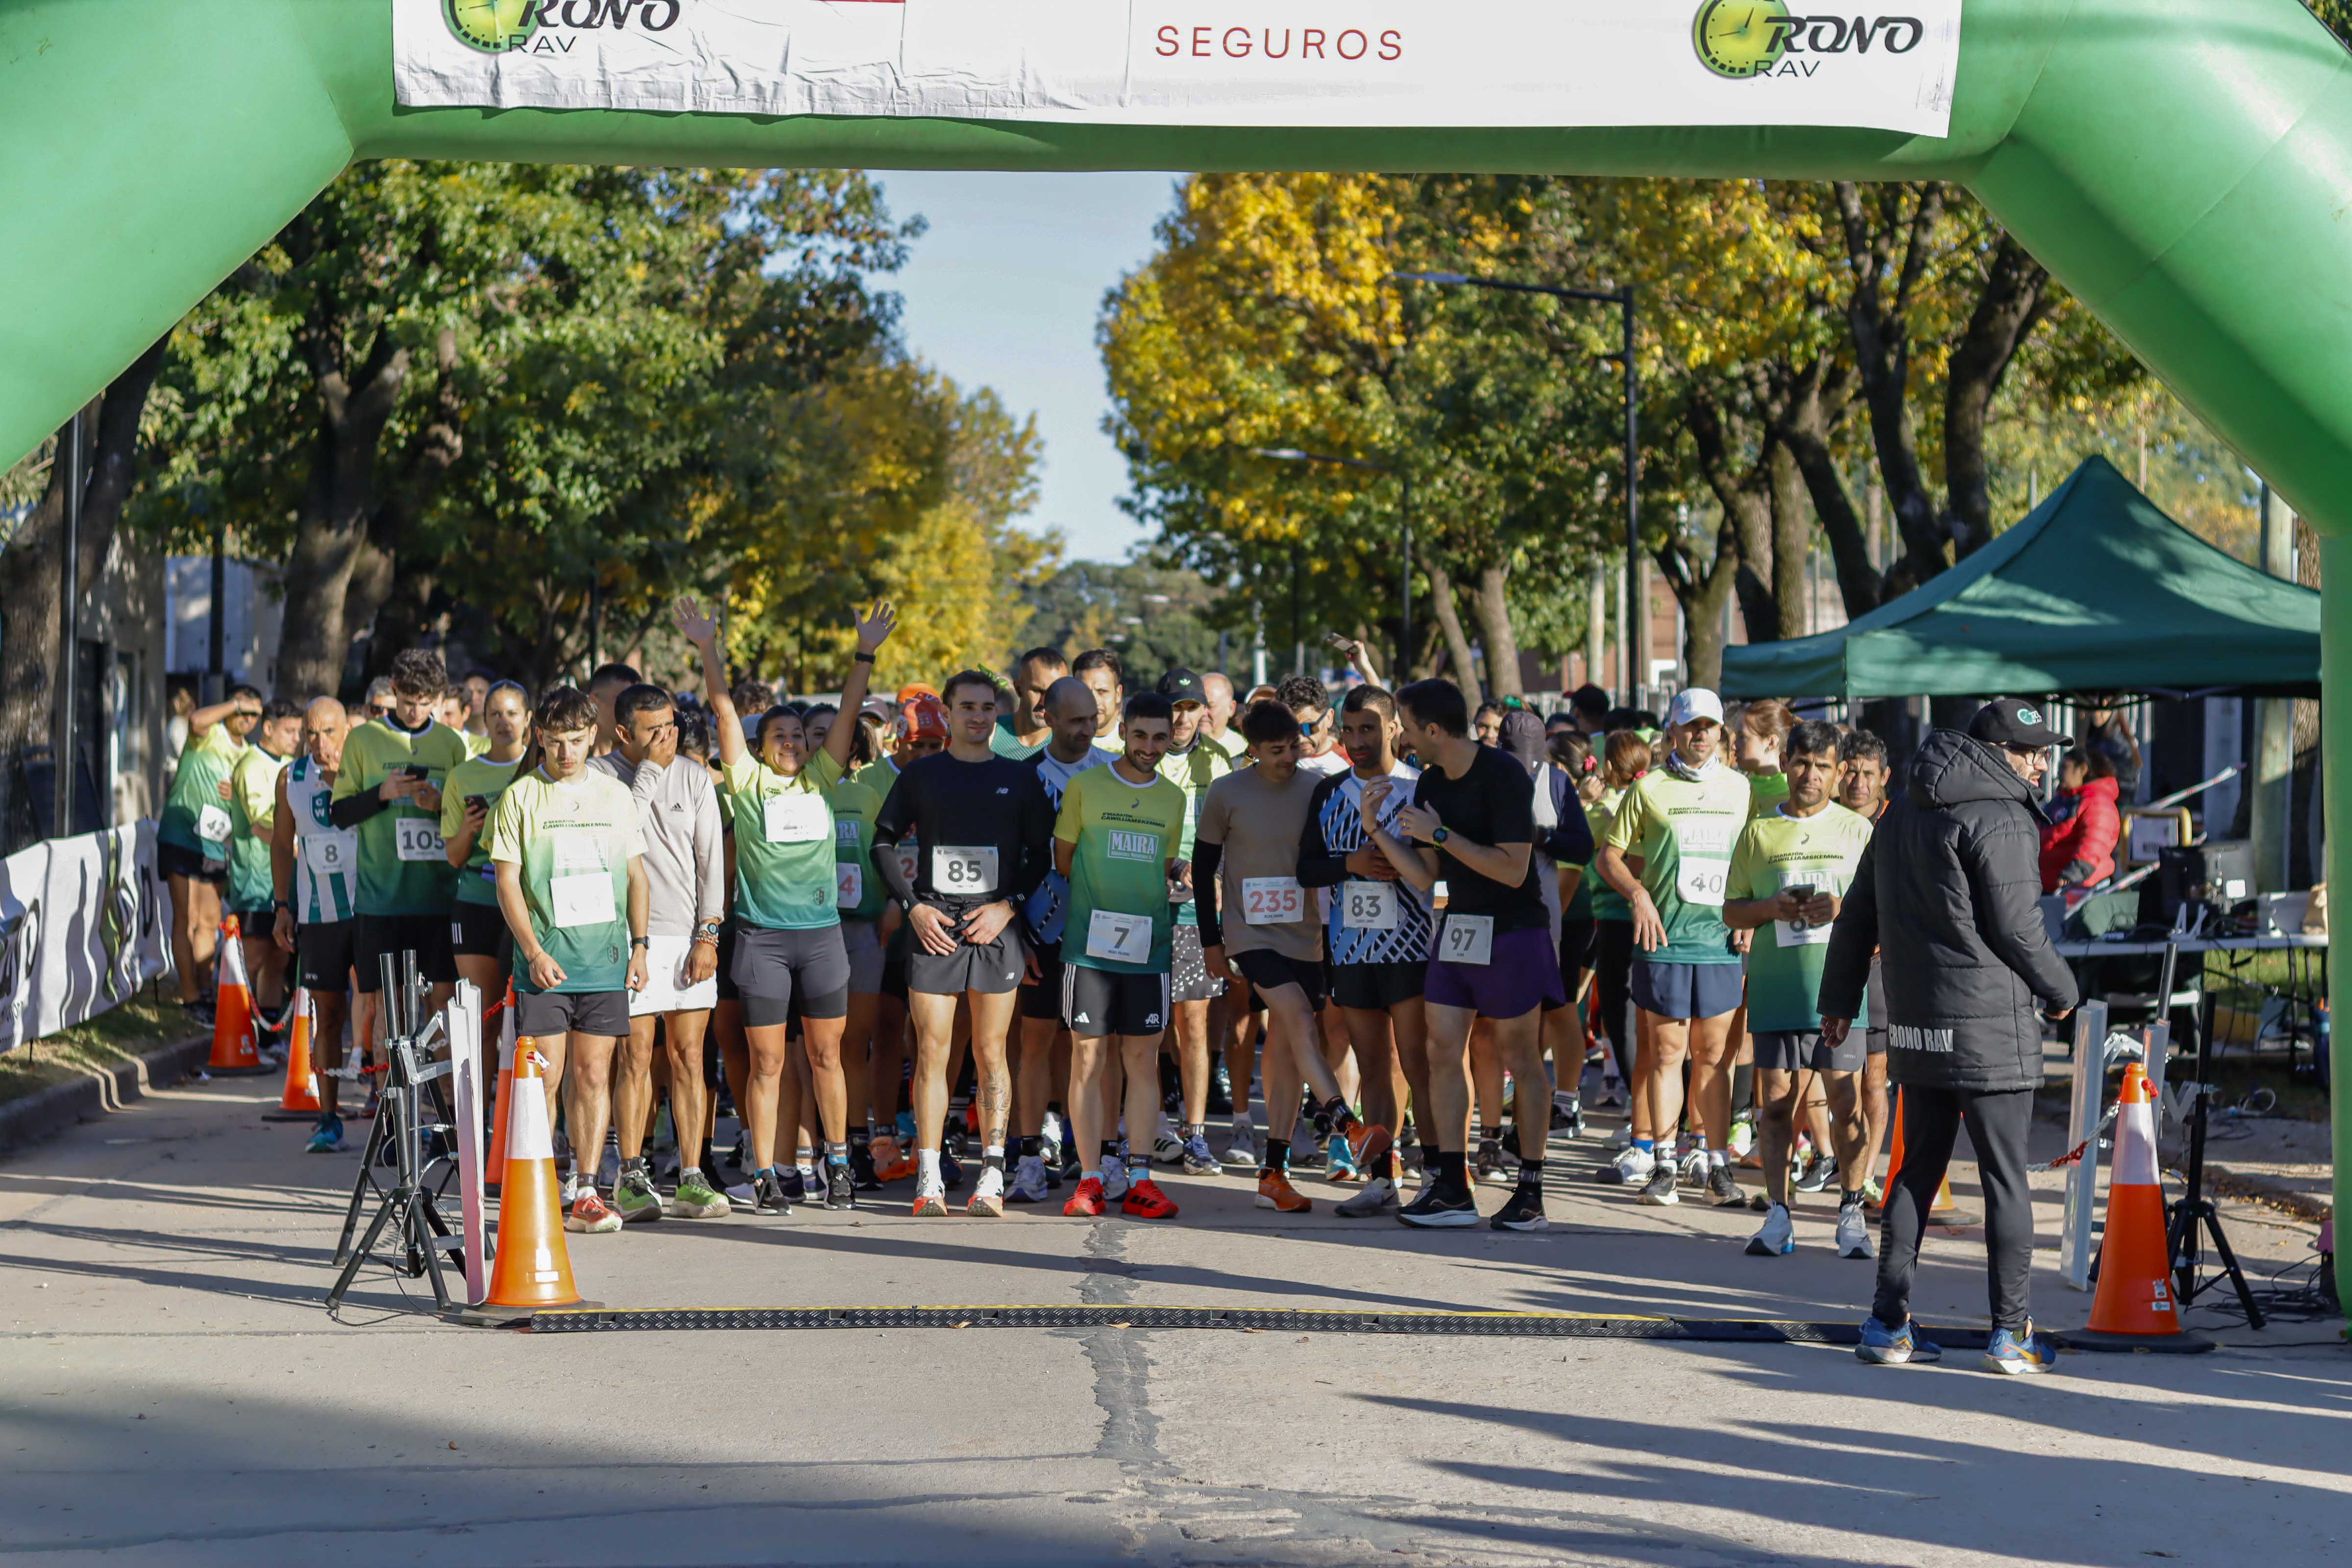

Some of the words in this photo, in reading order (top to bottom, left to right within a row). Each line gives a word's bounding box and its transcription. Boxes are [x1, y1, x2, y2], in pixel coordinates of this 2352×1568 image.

[508, 34, 577, 53] RAV
[1155, 25, 1402, 61] SEGUROS
[1754, 60, 1821, 77] RAV
[402, 831, 445, 850] 105
[1111, 833, 1155, 854] MAIRA
[324, 844, 338, 863] 8
[948, 860, 982, 882] 85
[1249, 889, 1298, 913] 235
[1351, 894, 1382, 918] 83
[1113, 926, 1130, 949] 7
[1450, 927, 1477, 951] 97
[1888, 1022, 1923, 1051] CRONO
[1924, 1028, 1954, 1053] RAV
